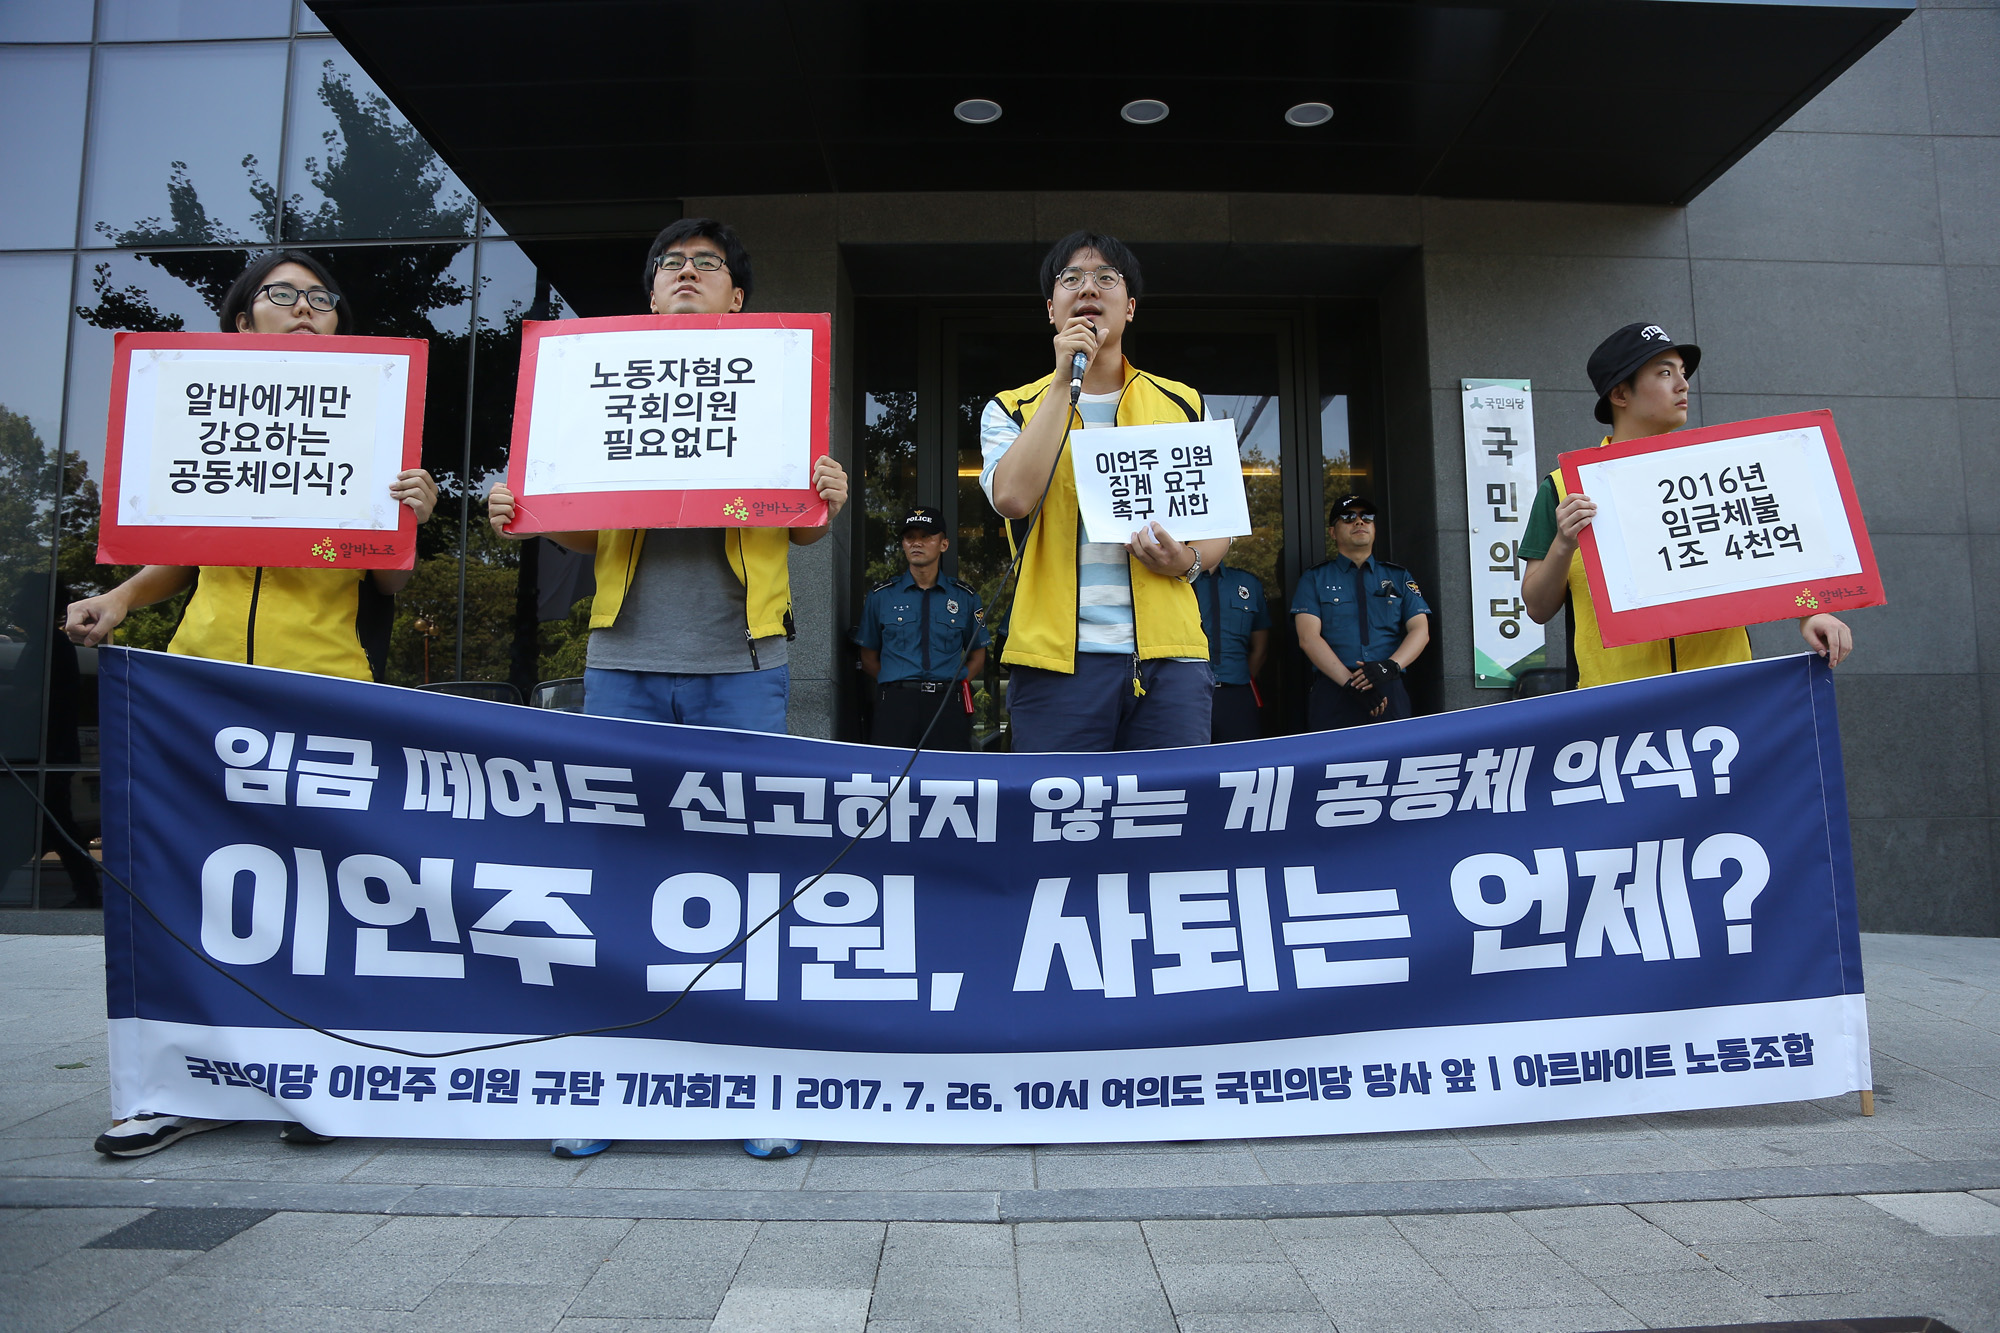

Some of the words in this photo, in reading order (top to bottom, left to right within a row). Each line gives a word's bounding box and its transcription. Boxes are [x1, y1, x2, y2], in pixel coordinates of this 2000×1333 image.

[590, 357, 756, 390] 노동자혐오
[185, 382, 351, 419] 알바에게만
[604, 391, 737, 425] 국회의원
[1485, 397, 1525, 410] 국민의당
[198, 421, 330, 457] 강요하는
[603, 426, 738, 461] 필요없다
[1095, 449, 1159, 474] 이언주
[1171, 445, 1213, 469] 의원
[169, 460, 354, 497] 공동체의식?
[1109, 473, 1152, 497] 징계
[1164, 469, 1206, 493] 요구
[1657, 462, 1768, 504] 2016년
[751, 500, 810, 517] 알바노조
[906, 515, 932, 524] POLICE
[1112, 497, 1155, 521] 촉구
[1168, 493, 1209, 518] 서한
[1661, 493, 1781, 539] 임금체불
[339, 542, 396, 558] 알바노조
[1657, 540, 1709, 572] 1조
[1725, 523, 1804, 560] 4천억
[1818, 585, 1869, 605] 알바노조
[214, 726, 380, 811] 임금
[402, 747, 646, 827] 떼여도
[669, 771, 999, 843] 신고하지
[1029, 774, 1189, 842] 않는
[1219, 765, 1295, 832] 게
[1315, 745, 1536, 828] 공동체
[1551, 725, 1740, 806] 의식?
[200, 843, 597, 987] 이언주
[646, 872, 964, 1011] 의원,
[1012, 865, 1412, 998] 사퇴는
[1450, 832, 1771, 975] 언제?
[185, 1055, 319, 1100] 국민의당
[328, 1065, 437, 1102] 이언주
[447, 1067, 521, 1104] 의원
[531, 1070, 605, 1106] 규탄
[616, 1072, 756, 1109] 기자회견
[1013, 1079, 1089, 1110] 10시
[1102, 1074, 1205, 1109] 여의도
[1215, 1065, 1353, 1104] 국민의당
[1362, 1061, 1432, 1098] 당사
[1440, 1058, 1477, 1094] 앞
[1513, 1043, 1676, 1088] 아르바이트
[1684, 1032, 1815, 1075] 노동조합
